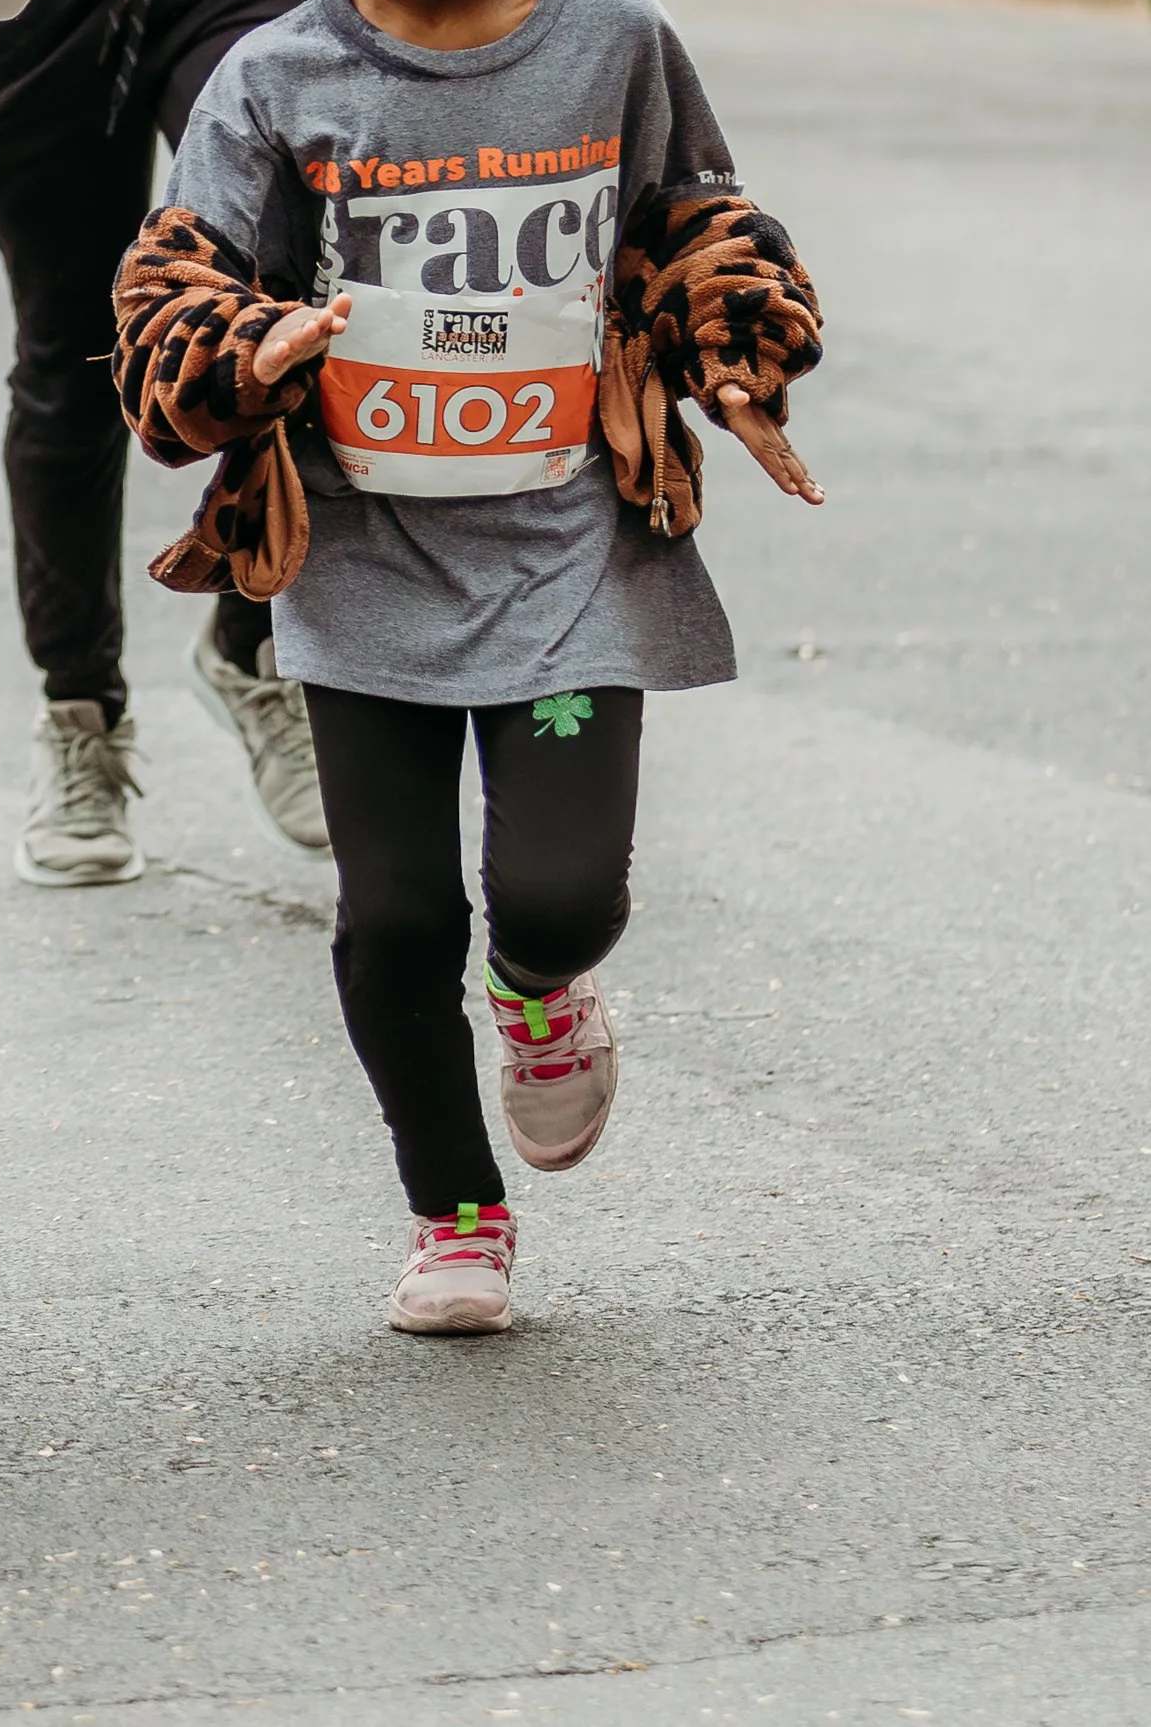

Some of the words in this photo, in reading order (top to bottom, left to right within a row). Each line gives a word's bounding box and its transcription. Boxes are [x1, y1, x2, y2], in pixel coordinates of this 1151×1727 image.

[349, 154, 467, 190] Years
[477, 134, 621, 181] Running
[348, 185, 619, 296] race
[422, 309, 436, 351] ywca
[436, 314, 508, 334] race
[438, 331, 505, 344] against
[435, 341, 507, 354] RACISM
[491, 353, 505, 362] PA
[355, 378, 556, 447] 6102
